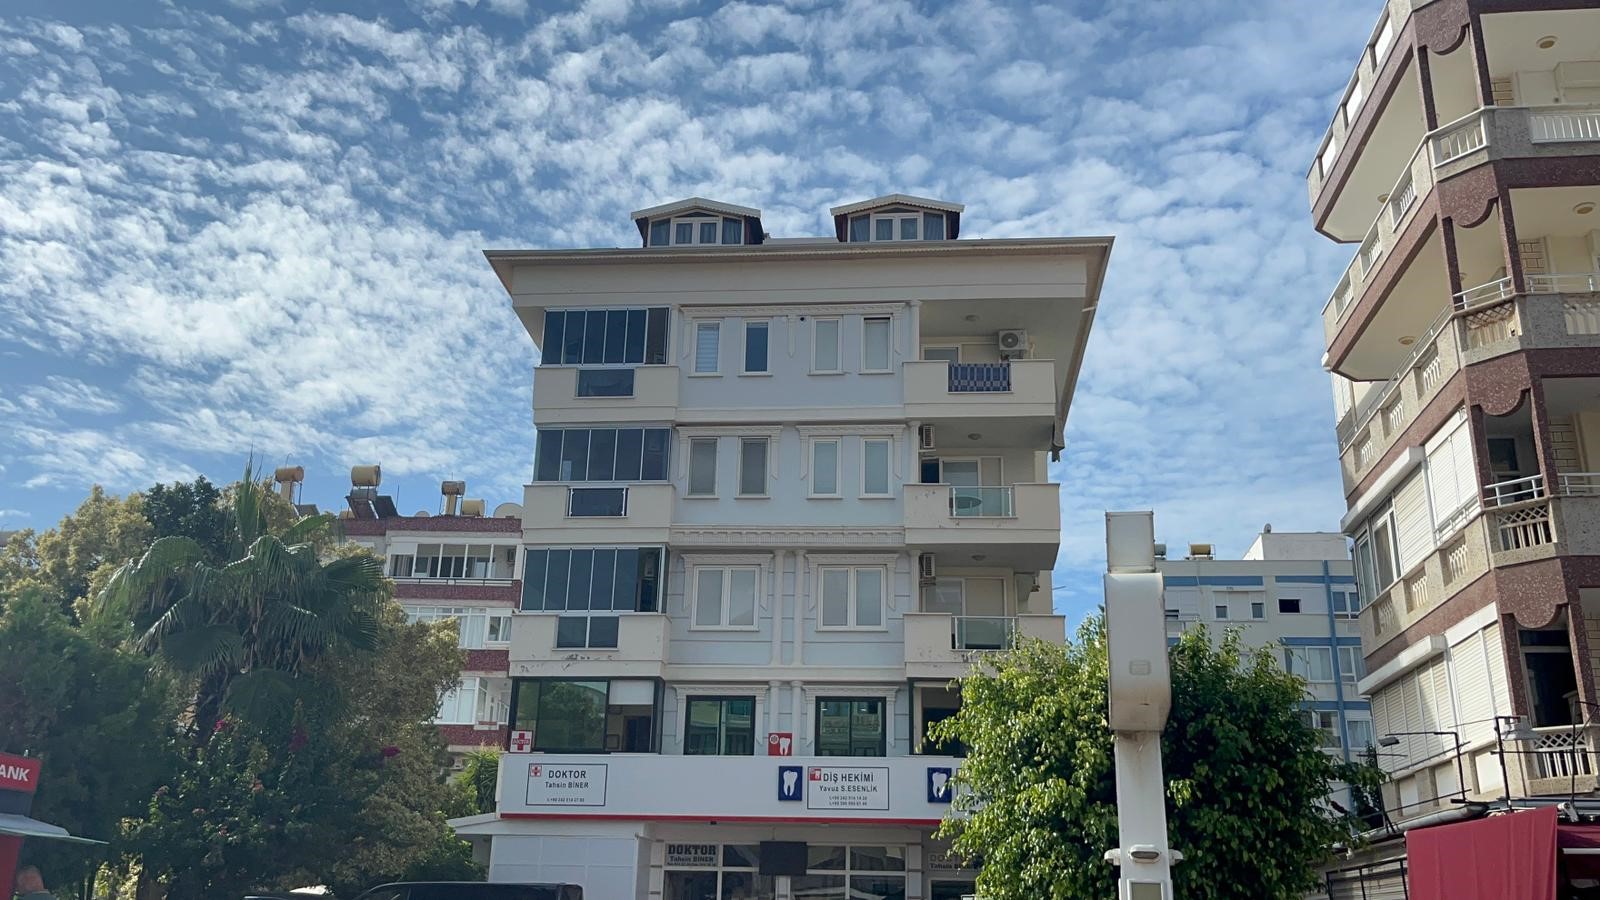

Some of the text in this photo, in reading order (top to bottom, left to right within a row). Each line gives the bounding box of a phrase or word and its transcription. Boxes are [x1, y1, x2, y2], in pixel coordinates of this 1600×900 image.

[0, 764, 30, 782] ANK
[548, 770, 587, 779] DOKTOR
[823, 772, 874, 783] DİŞ HEKİMİ
[545, 781, 567, 789] Tahsin
[668, 844, 717, 855] DOKTOR
